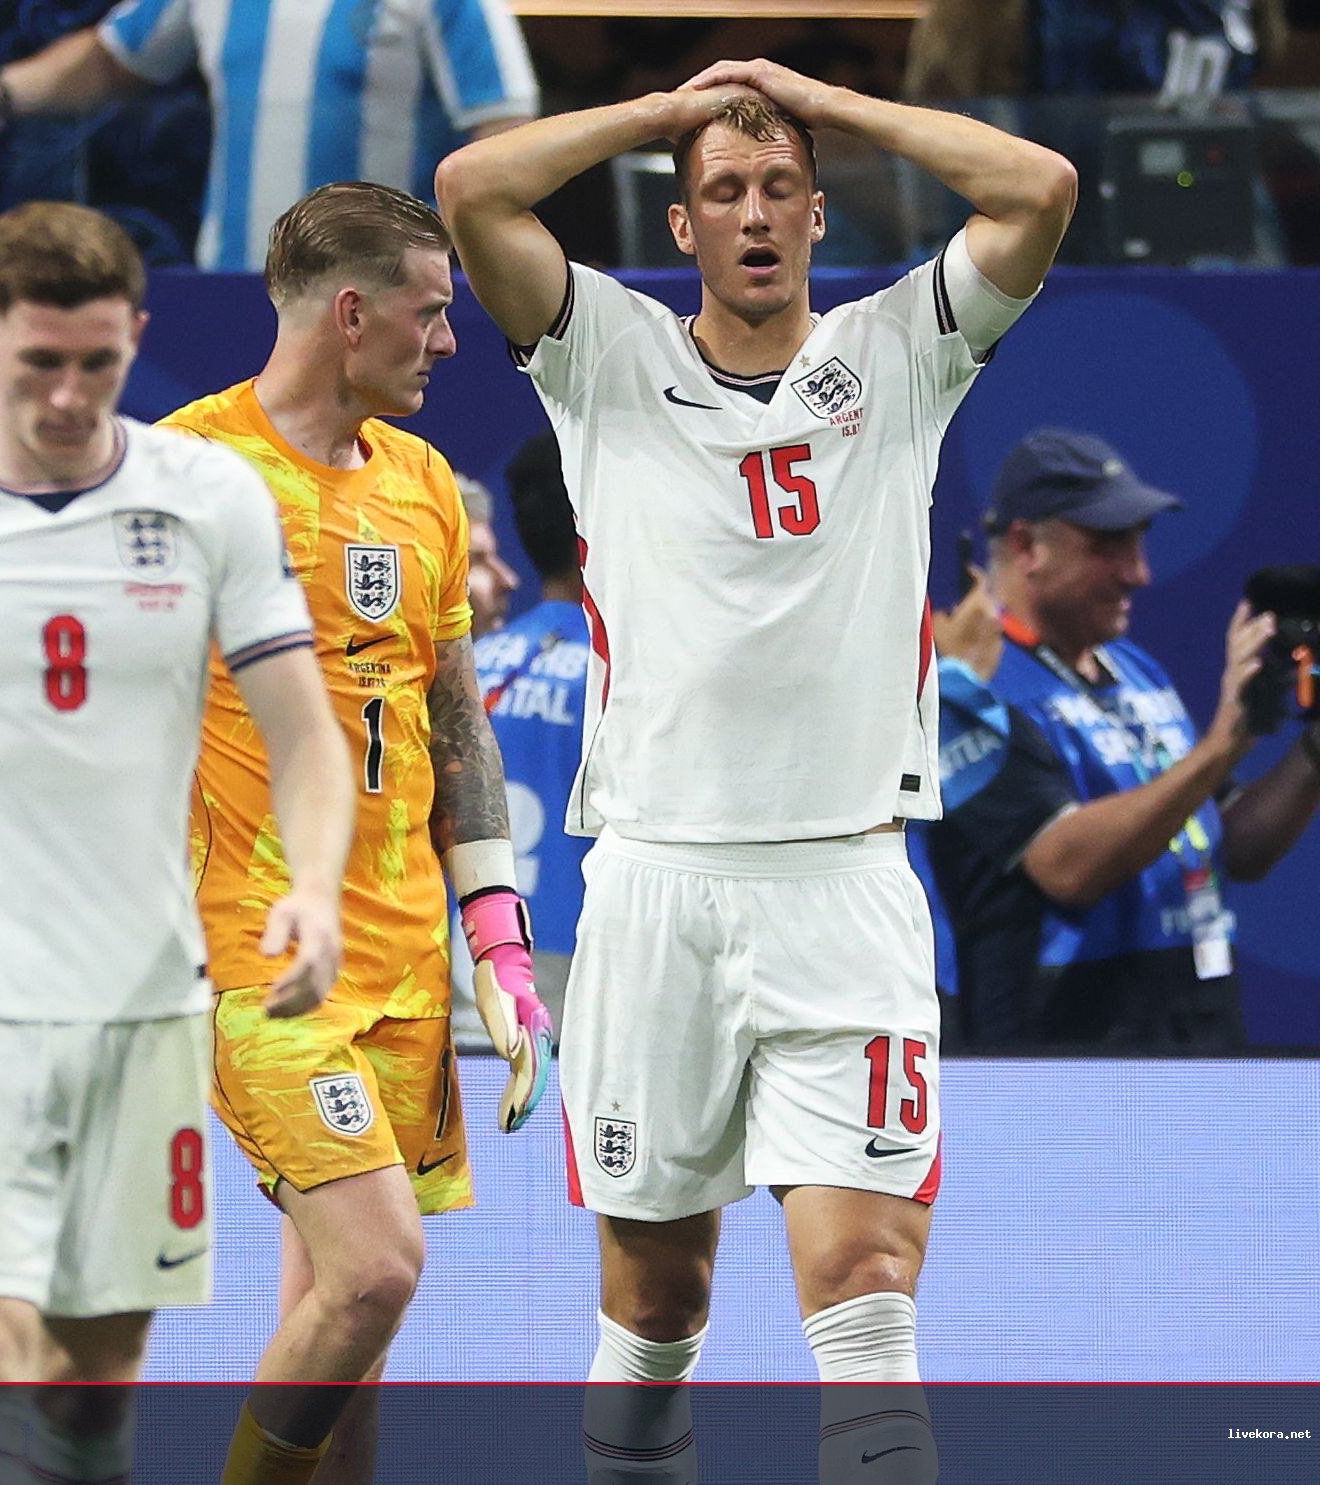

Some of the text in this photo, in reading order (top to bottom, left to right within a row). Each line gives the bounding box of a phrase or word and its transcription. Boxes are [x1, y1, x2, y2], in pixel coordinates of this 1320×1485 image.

[830, 408, 863, 426] ARGENT
[739, 443, 821, 538] 15
[43, 613, 86, 711] 8
[361, 696, 384, 793] 1
[864, 1035, 928, 1135] 15
[171, 1127, 203, 1229] 8
